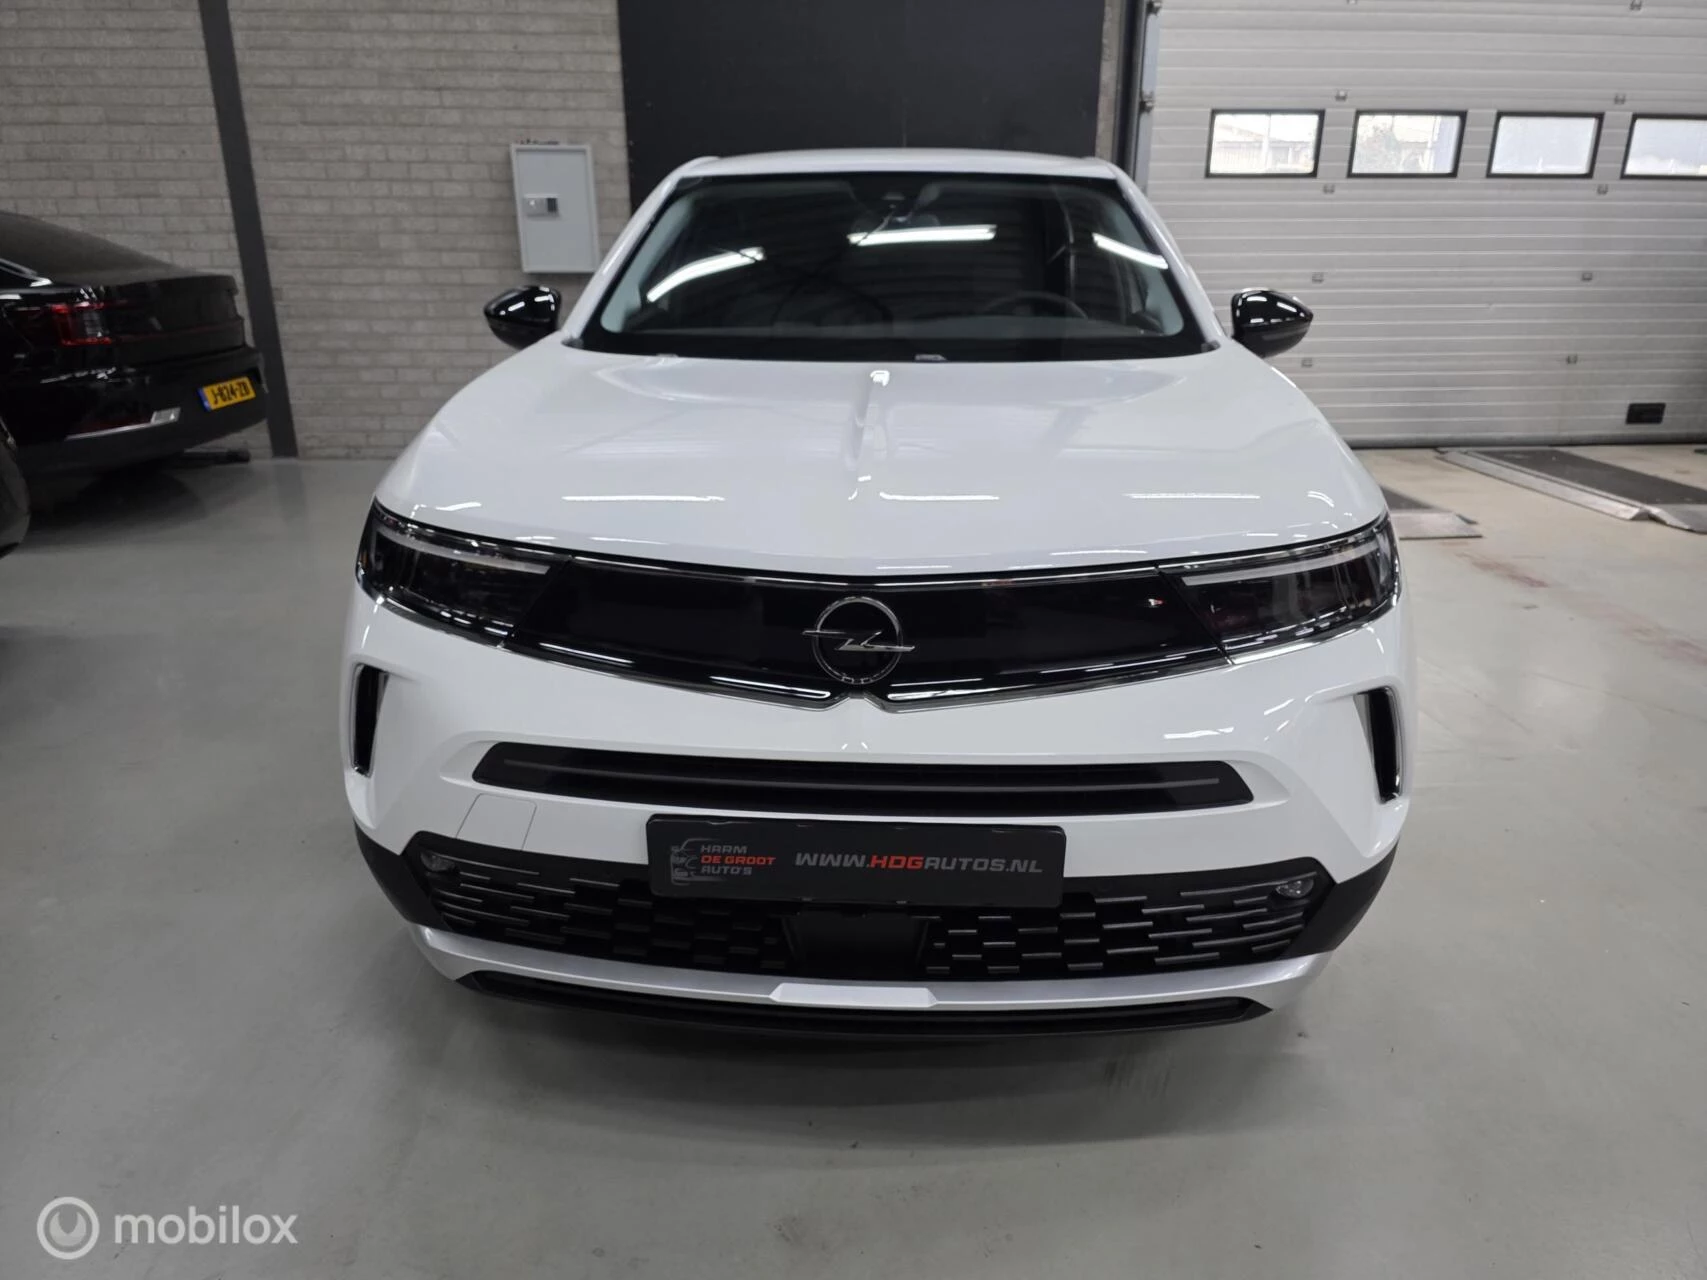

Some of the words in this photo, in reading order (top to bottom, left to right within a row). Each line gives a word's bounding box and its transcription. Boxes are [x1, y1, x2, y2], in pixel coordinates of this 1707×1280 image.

[700, 844, 748, 855] HARM
[701, 854, 721, 864] DE
[724, 855, 777, 866] GROOT
[795, 852, 1044, 873] WWW.HDGAUTOS.NL
